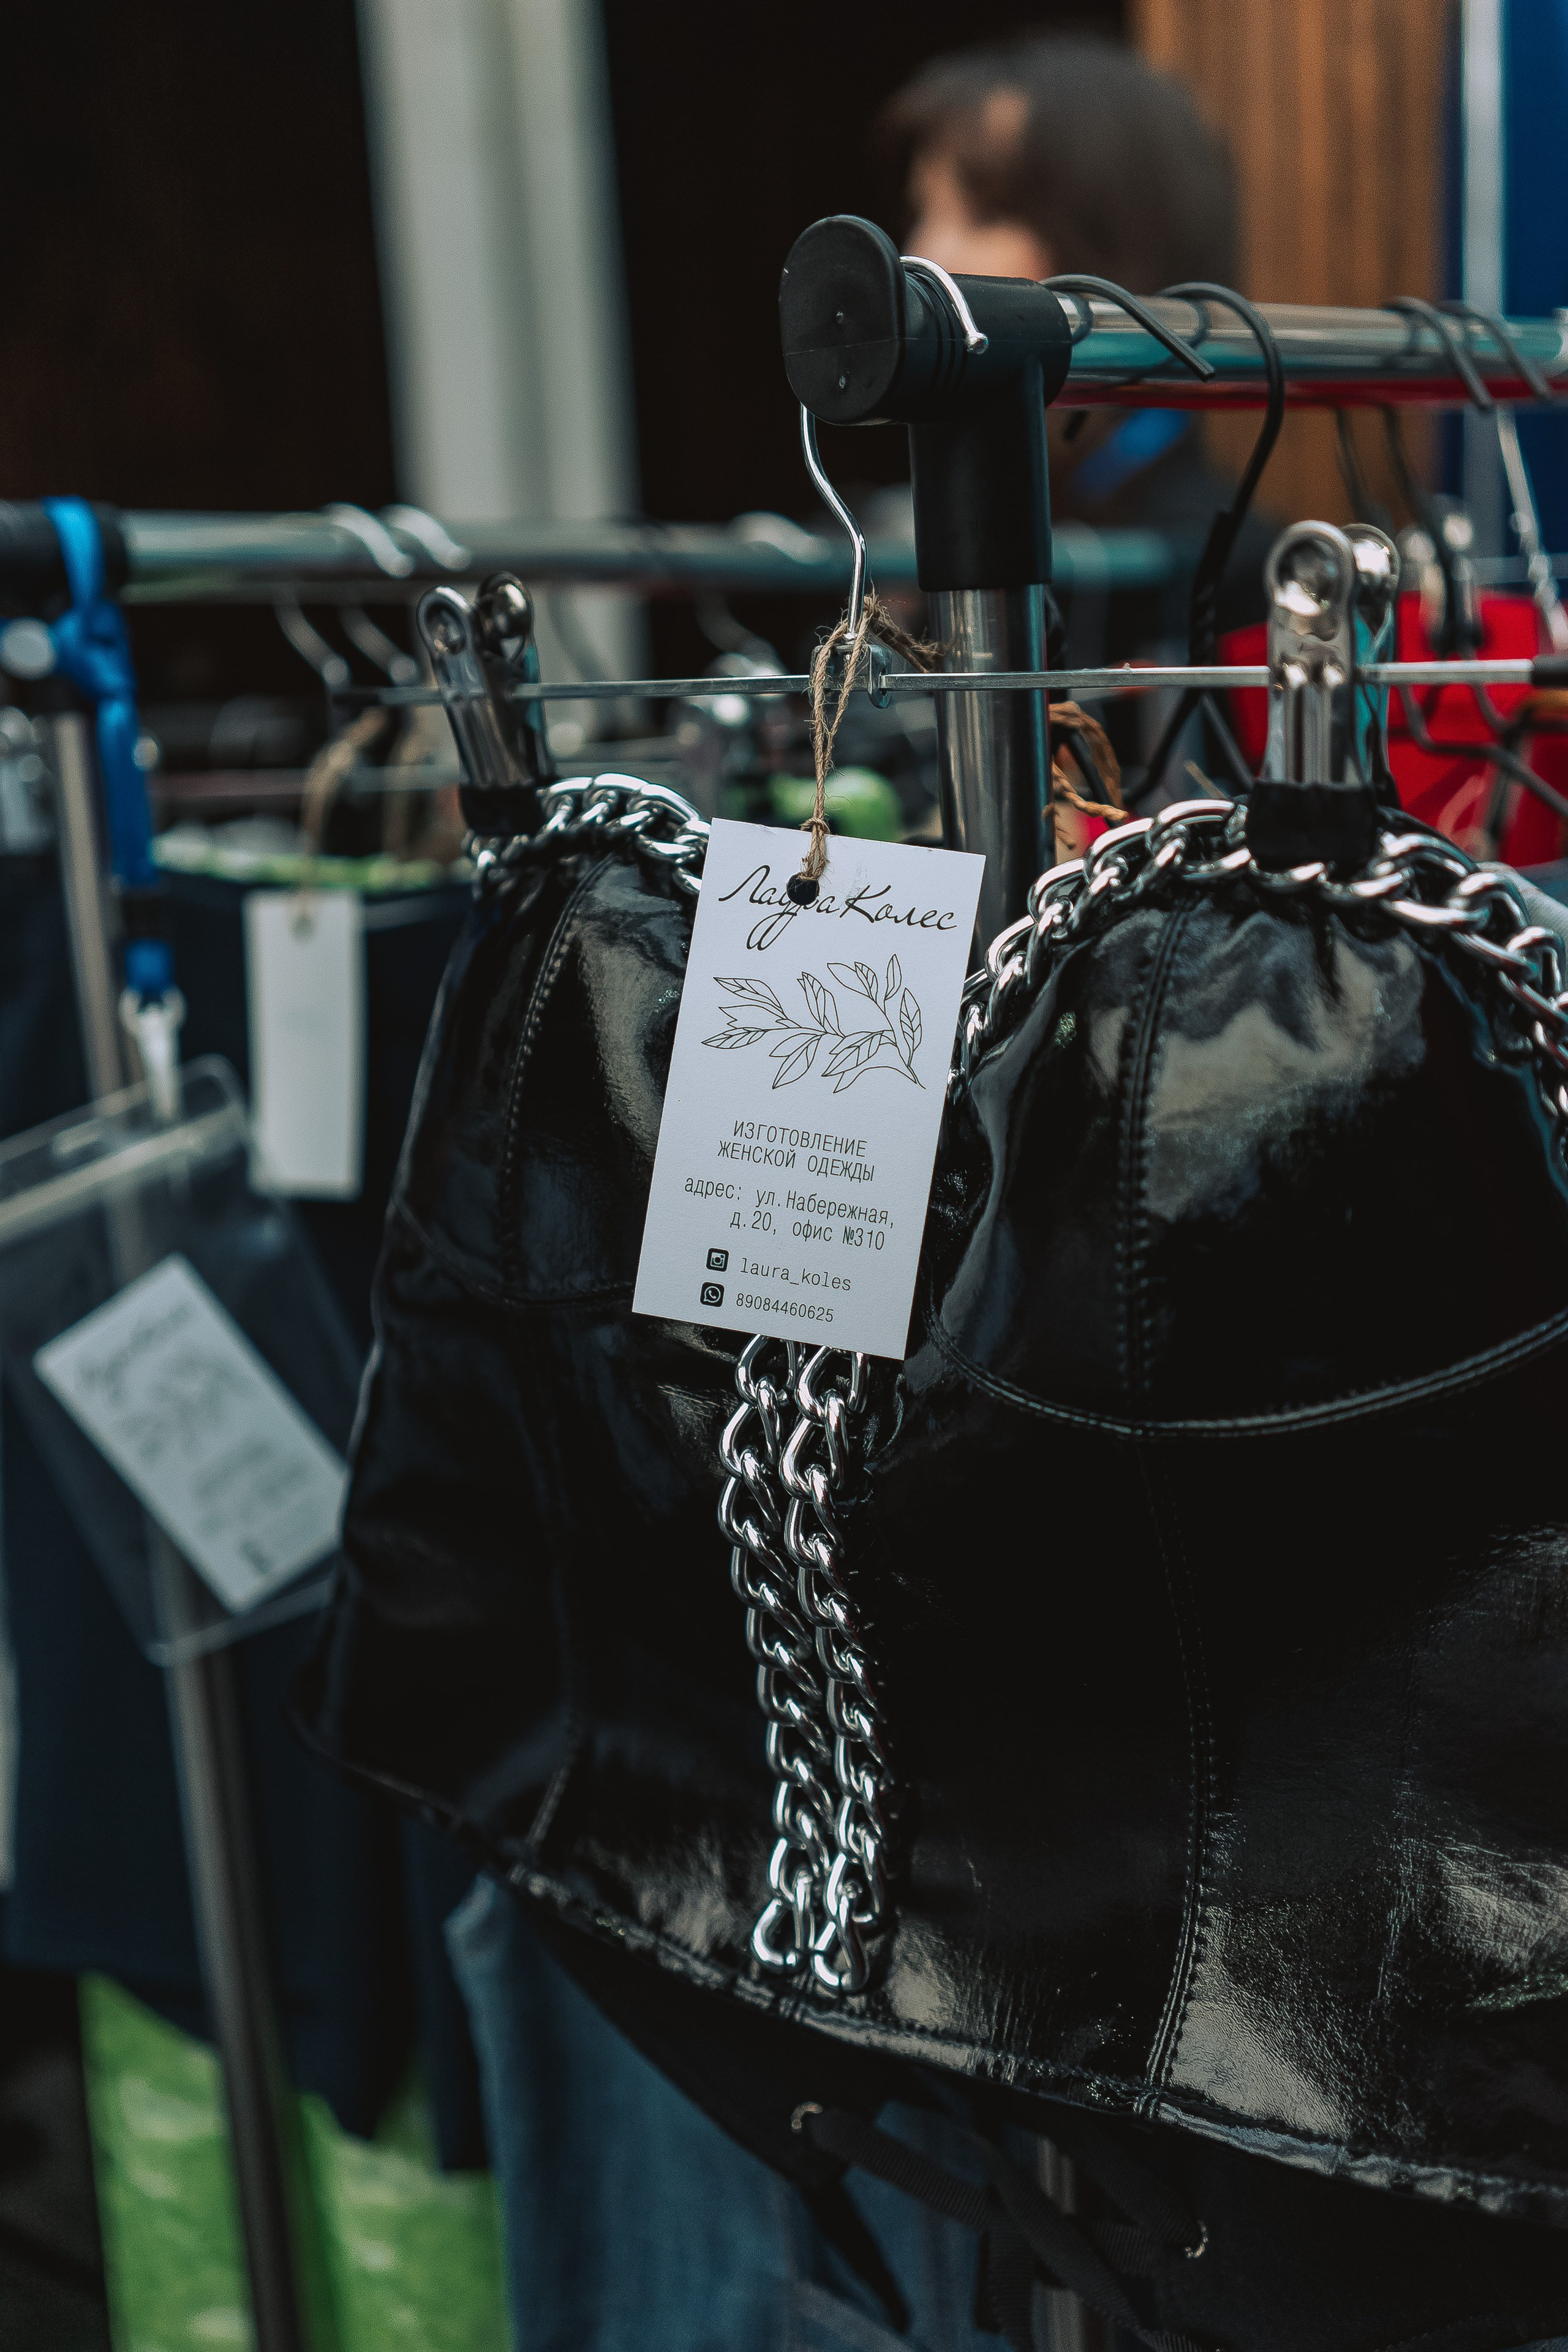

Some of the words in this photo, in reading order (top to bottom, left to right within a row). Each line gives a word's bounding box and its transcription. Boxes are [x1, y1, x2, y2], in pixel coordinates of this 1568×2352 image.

[839, 884, 957, 930] Колес
[733, 1120, 868, 1157] ИЗГОТОВЛЕНИЕ
[717, 1140, 796, 1169] ЖЕНСКОЙ
[807, 1155, 875, 1183] ОДЕЖДЫ
[684, 1177, 742, 1200] адрес:
[792, 1219, 832, 1242] офис
[842, 1226, 885, 1250] №310
[740, 1257, 851, 1291] laura_koles
[736, 1293, 834, 1322] 89084460625
